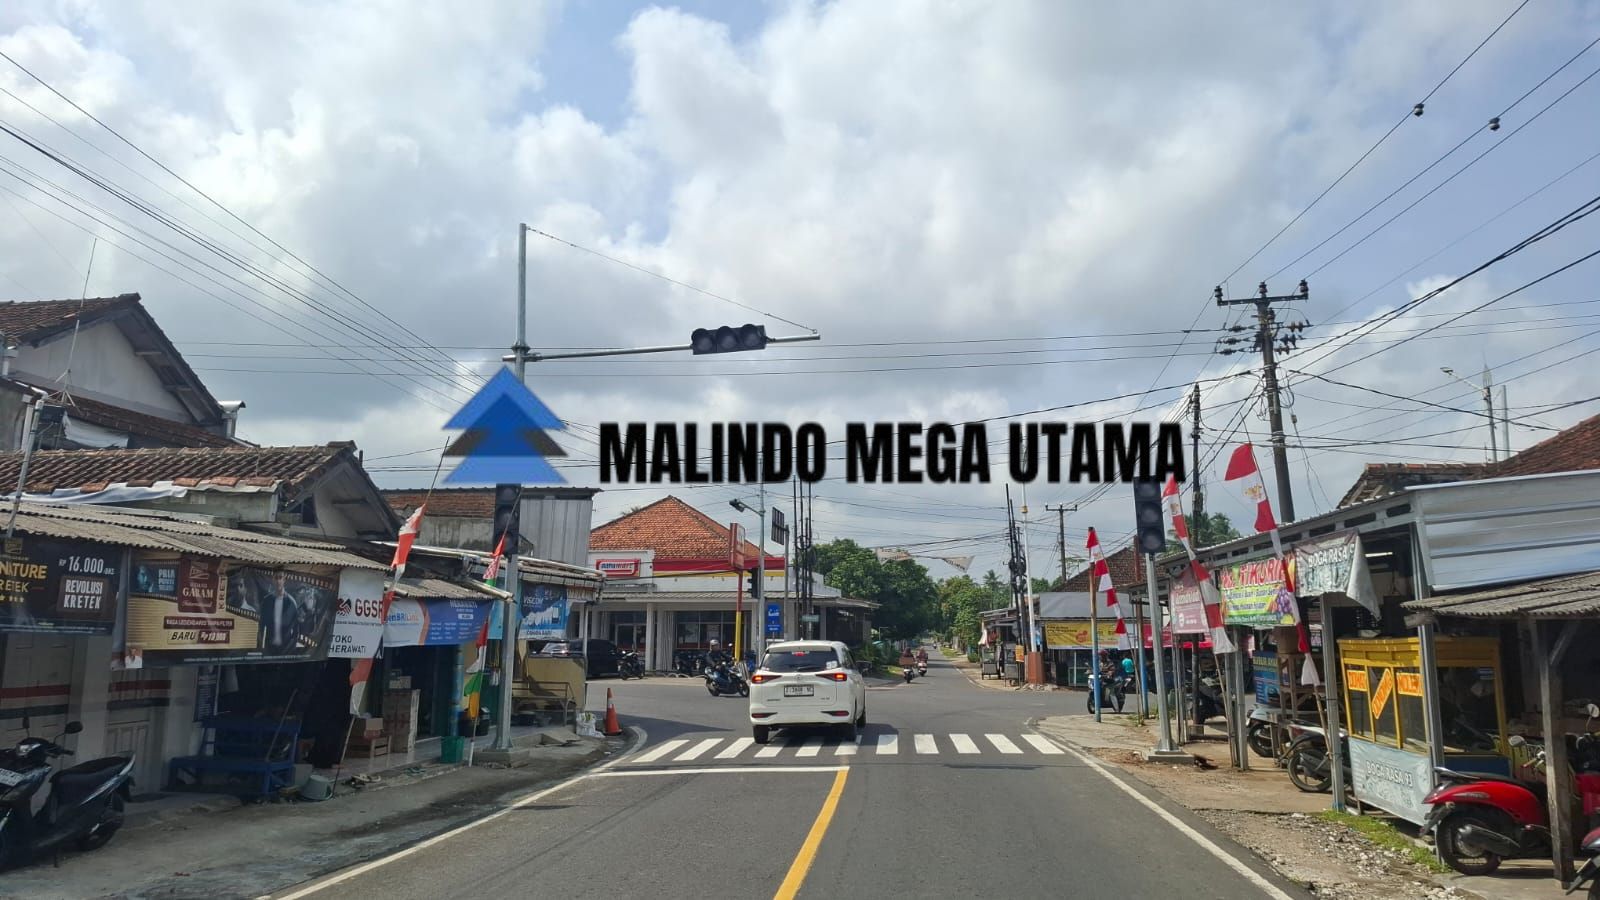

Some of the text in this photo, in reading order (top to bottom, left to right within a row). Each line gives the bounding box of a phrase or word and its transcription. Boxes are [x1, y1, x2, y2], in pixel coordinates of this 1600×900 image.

[68, 556, 104, 573] 16.000
[65, 579, 104, 594] REVOLUSI
[182, 587, 214, 598] GARAM
[63, 594, 102, 609] KRETEK
[171, 631, 196, 640] BARU
[1366, 760, 1386, 779] BOGA
[1387, 768, 1404, 784] RASA
